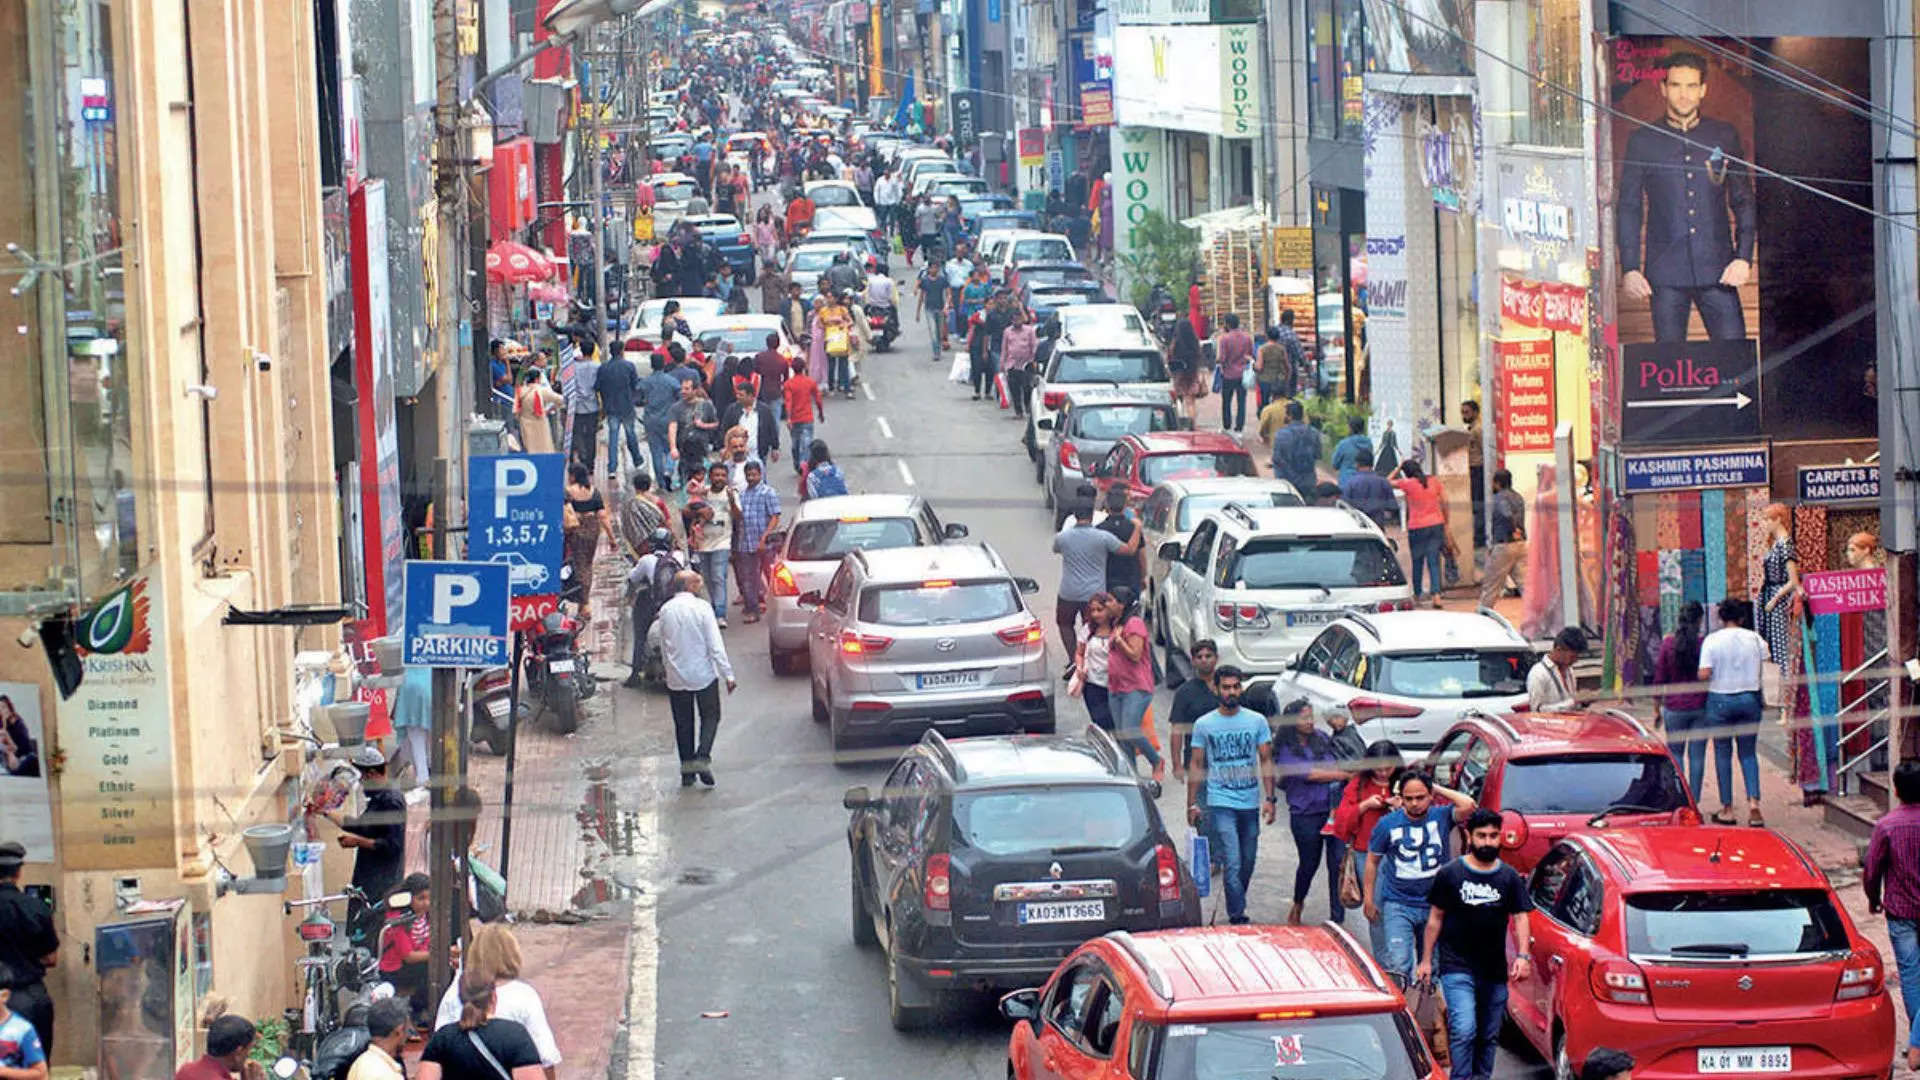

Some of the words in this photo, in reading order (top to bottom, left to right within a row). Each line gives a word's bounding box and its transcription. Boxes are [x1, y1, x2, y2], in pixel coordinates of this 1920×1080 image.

[1504, 354, 1551, 370] FRAGRANCE
[1512, 373, 1544, 388] Perfumes
[1640, 358, 1720, 388] Polka
[1628, 457, 1691, 475] KASHMIR
[1695, 454, 1764, 471] PASHMINA
[1650, 474, 1692, 487] SHAWLS
[1695, 473, 1703, 483] &
[1705, 471, 1744, 483] STOLES
[1806, 470, 1865, 483] CARPETS
[495, 459, 538, 518] P
[1806, 482, 1879, 498] HANGINGS
[485, 524, 549, 547] 1,3,5,7
[1808, 574, 1887, 593] PASHMINA
[433, 573, 480, 624] P
[1848, 590, 1880, 607] SILK
[411, 637, 498, 656] PARKING
[87, 699, 138, 710] Diamond
[88, 727, 140, 738] Platinum
[102, 754, 129, 766] Gold
[99, 781, 136, 792] Ethnic
[101, 807, 135, 819] Silver
[1027, 903, 1104, 922] KA03MT3665
[1701, 1056, 1715, 1069] KA
[1719, 1055, 1731, 1068] 01
[1737, 1056, 1753, 1068] MM
[1759, 1053, 1788, 1068] 8892
